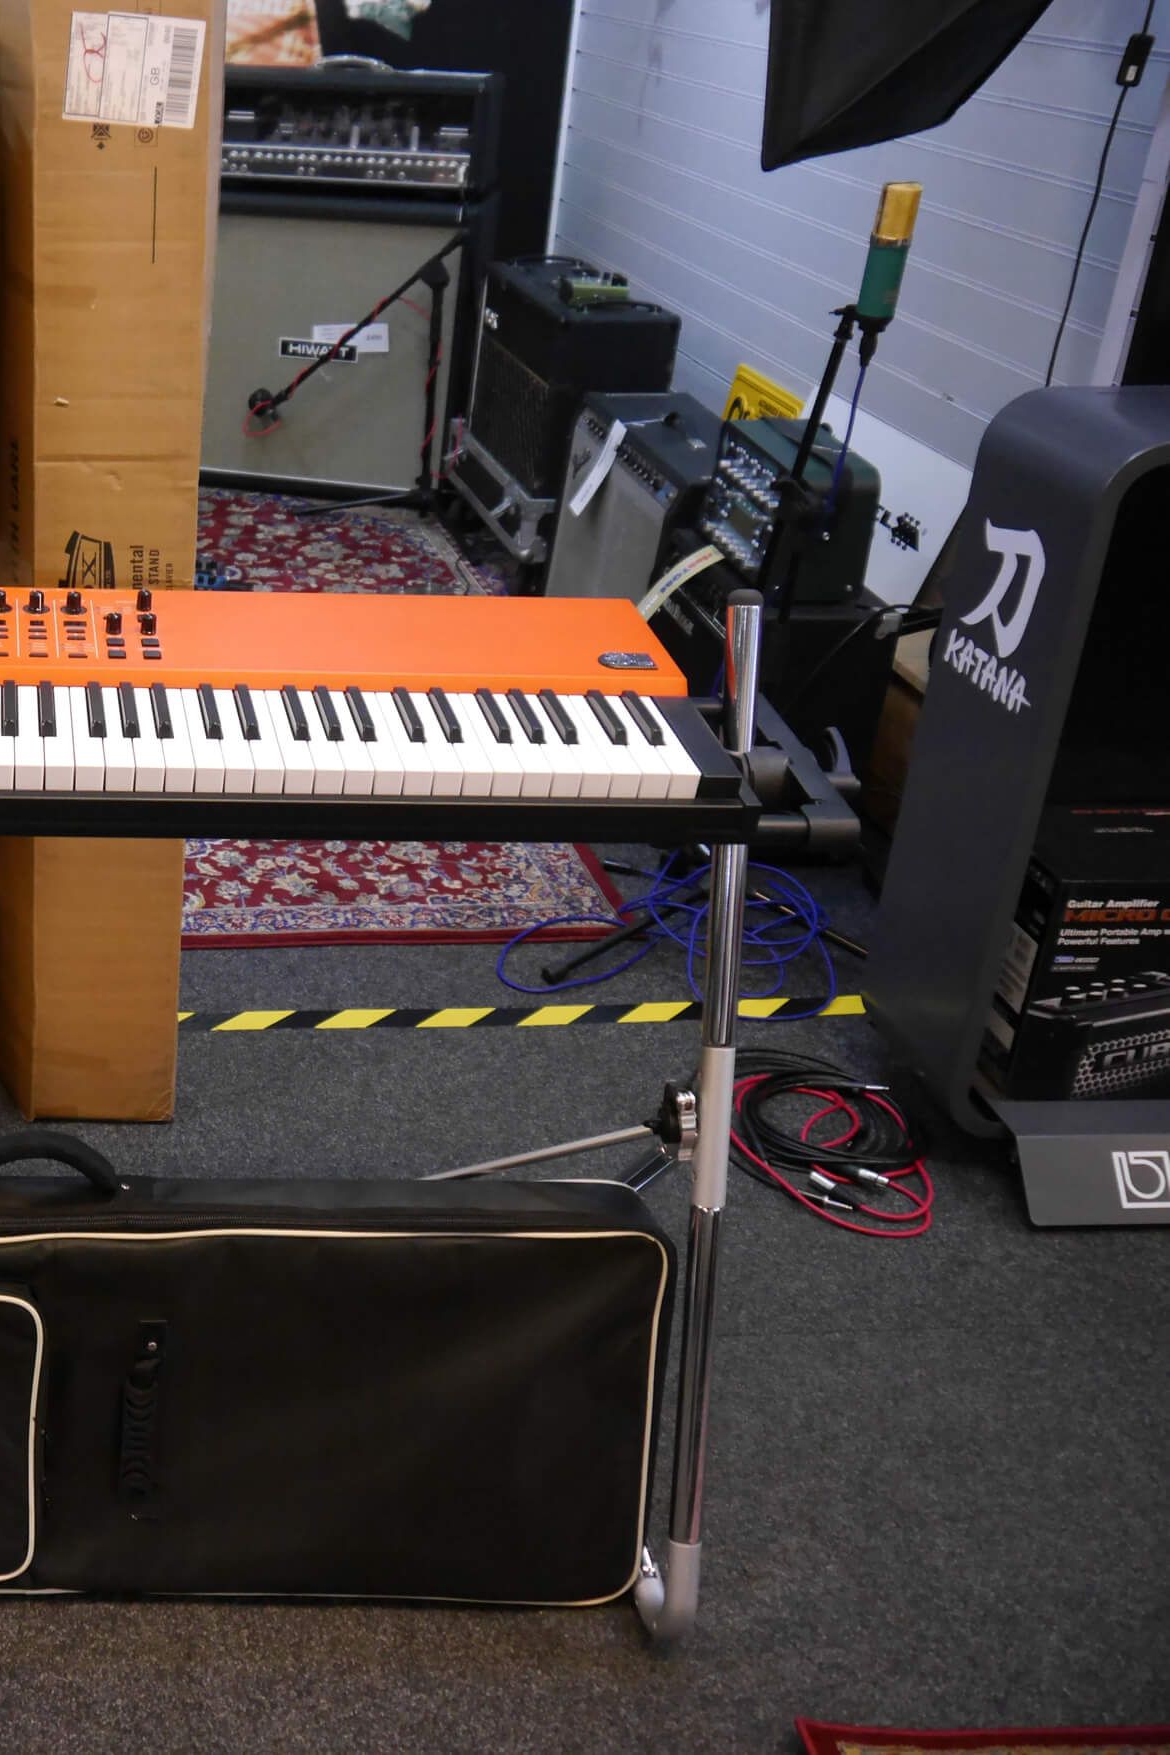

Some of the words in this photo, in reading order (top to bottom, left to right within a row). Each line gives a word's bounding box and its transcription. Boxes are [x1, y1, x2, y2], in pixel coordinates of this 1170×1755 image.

[149, 67, 161, 86] GB
[288, 343, 350, 359] HIWAT
[148, 549, 160, 584] STAND
[943, 627, 1031, 714] KATANA
[1066, 900, 1104, 909] Guitar
[1106, 899, 1160, 909] Amplifier
[1063, 909, 1157, 922] MICRO
[1060, 929, 1098, 937] Ultimate
[1100, 928, 1139, 937] Portable
[1140, 928, 1162, 938] Amp
[1057, 938, 1098, 946] Powerful
[1100, 937, 1140, 945] Features
